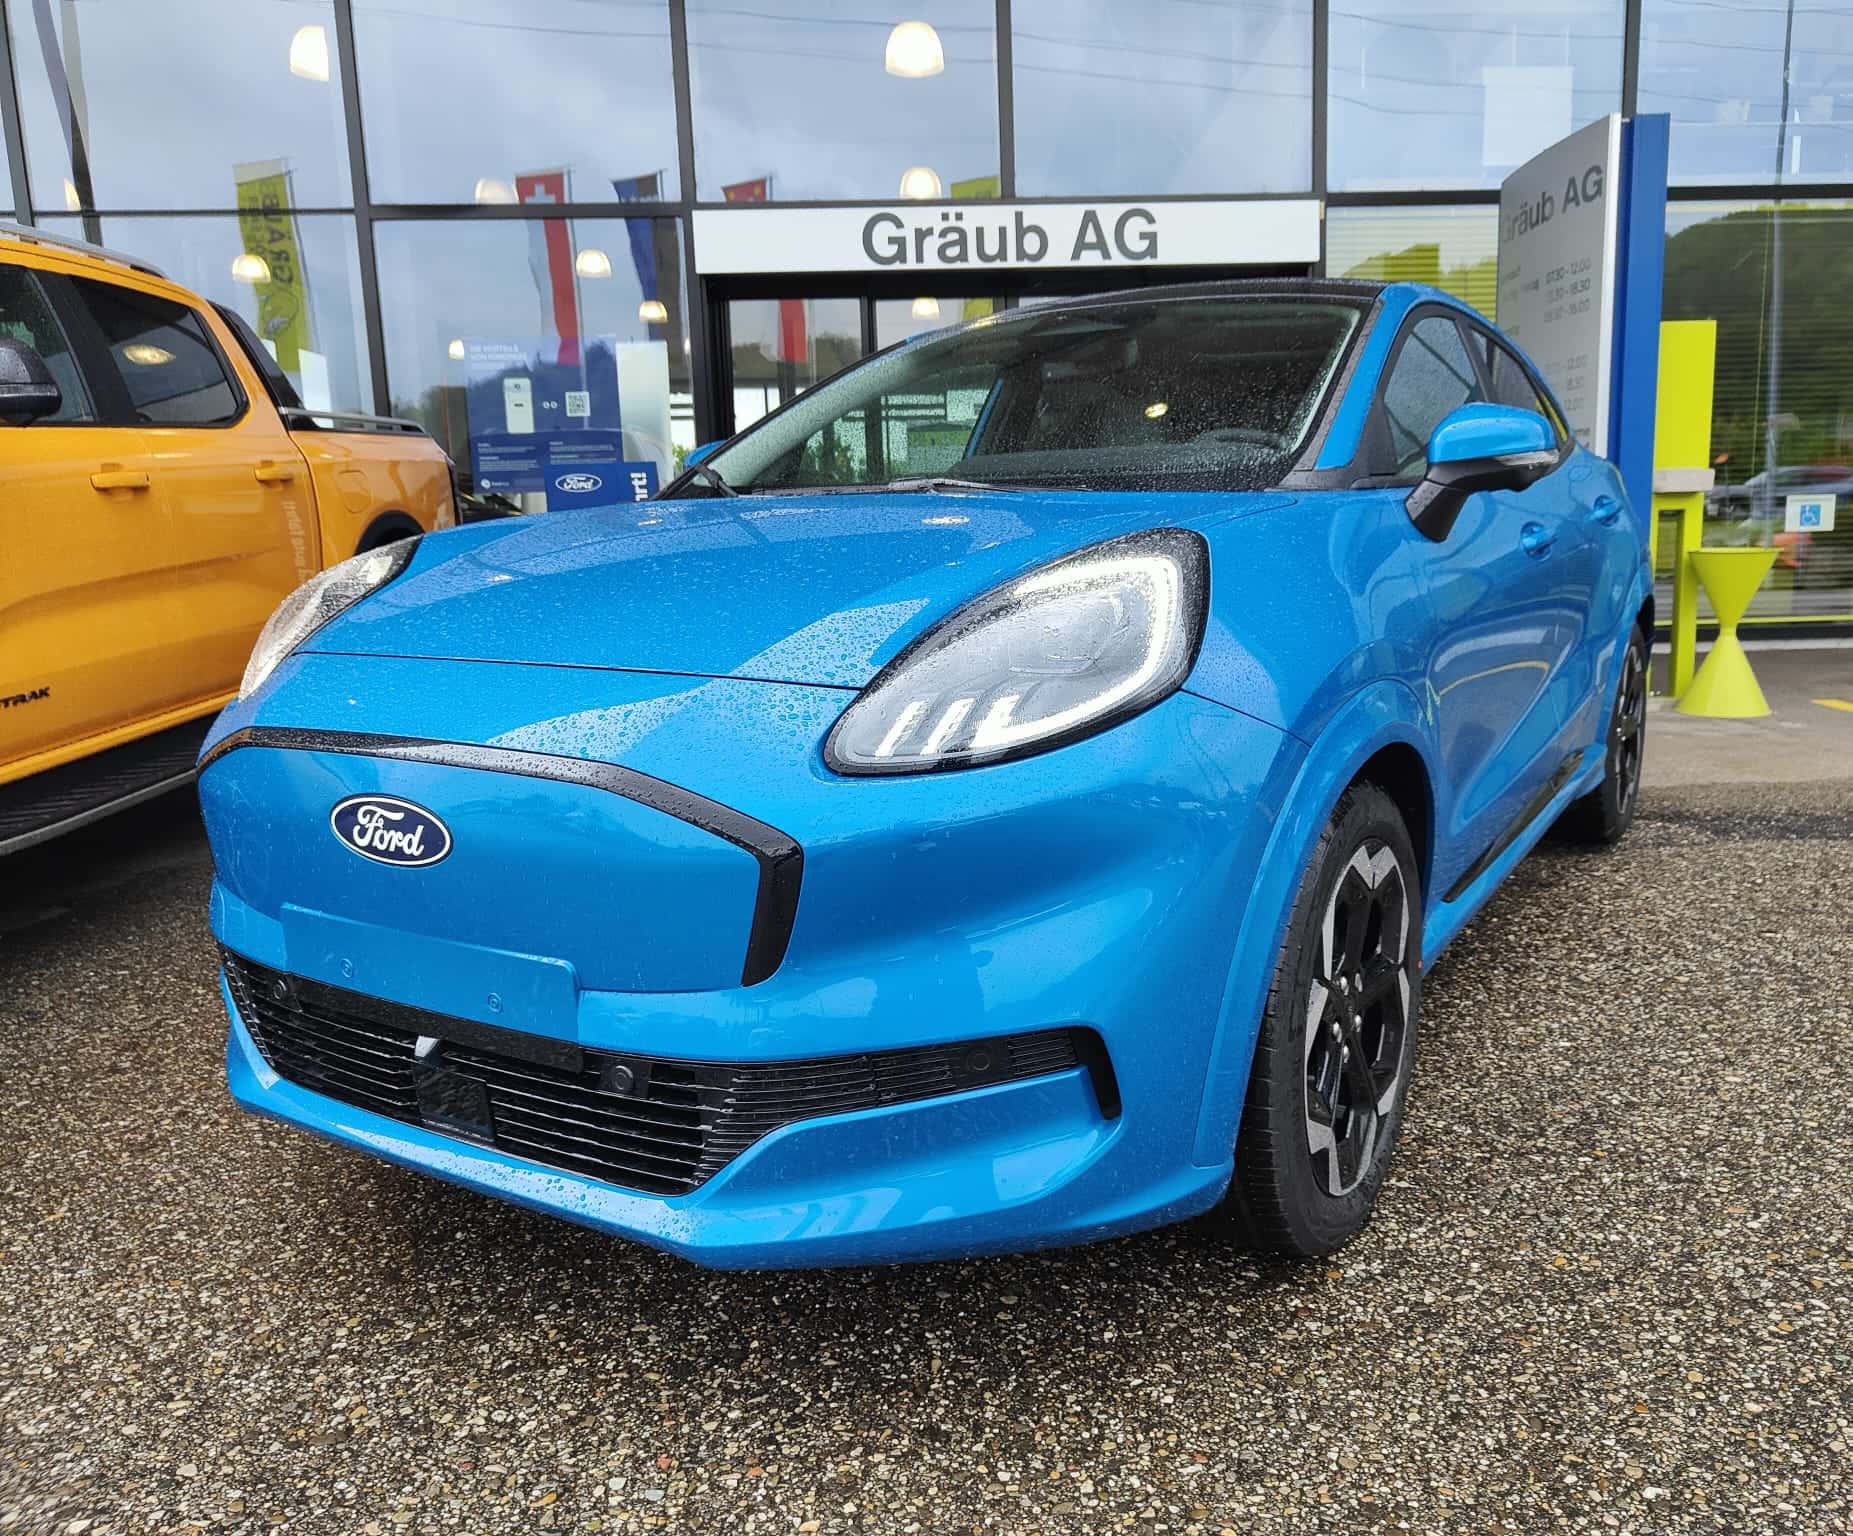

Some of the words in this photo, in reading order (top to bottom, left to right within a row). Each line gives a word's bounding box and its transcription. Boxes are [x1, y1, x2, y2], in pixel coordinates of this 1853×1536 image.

[1562, 165, 1603, 214] AG
[862, 211, 1049, 266] Gräub
[1070, 208, 1159, 262] AG
[563, 475, 594, 490] Ford
[352, 804, 425, 857] Ford
